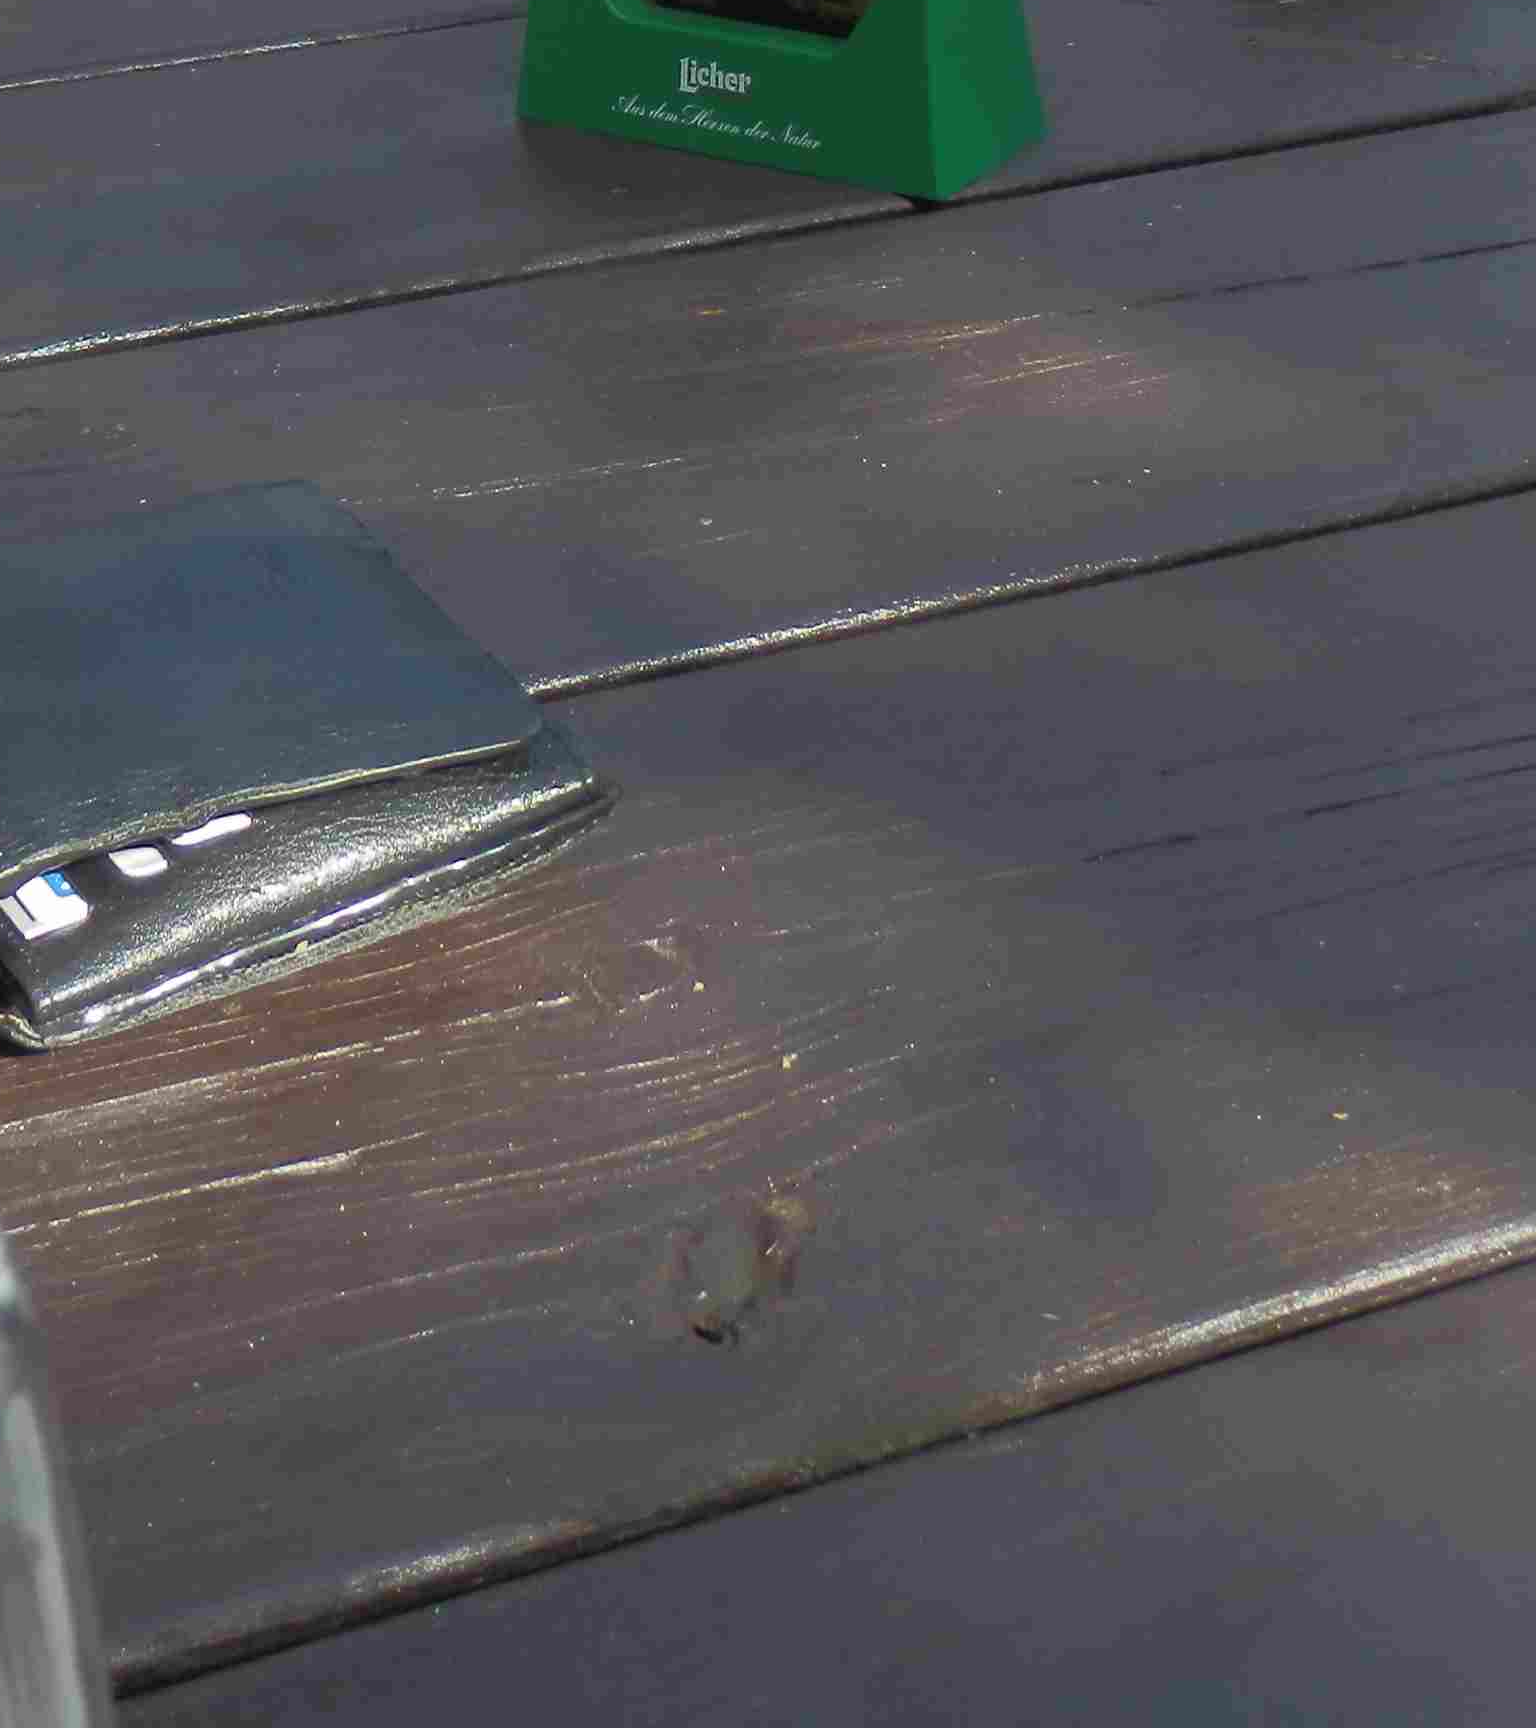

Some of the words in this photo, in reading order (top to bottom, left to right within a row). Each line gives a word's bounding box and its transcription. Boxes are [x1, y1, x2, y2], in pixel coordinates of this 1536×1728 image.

[679, 56, 751, 94] Licher
[611, 92, 646, 118] Aus
[648, 102, 678, 123] dem
[743, 120, 771, 140] der
[771, 123, 823, 150] Natur
